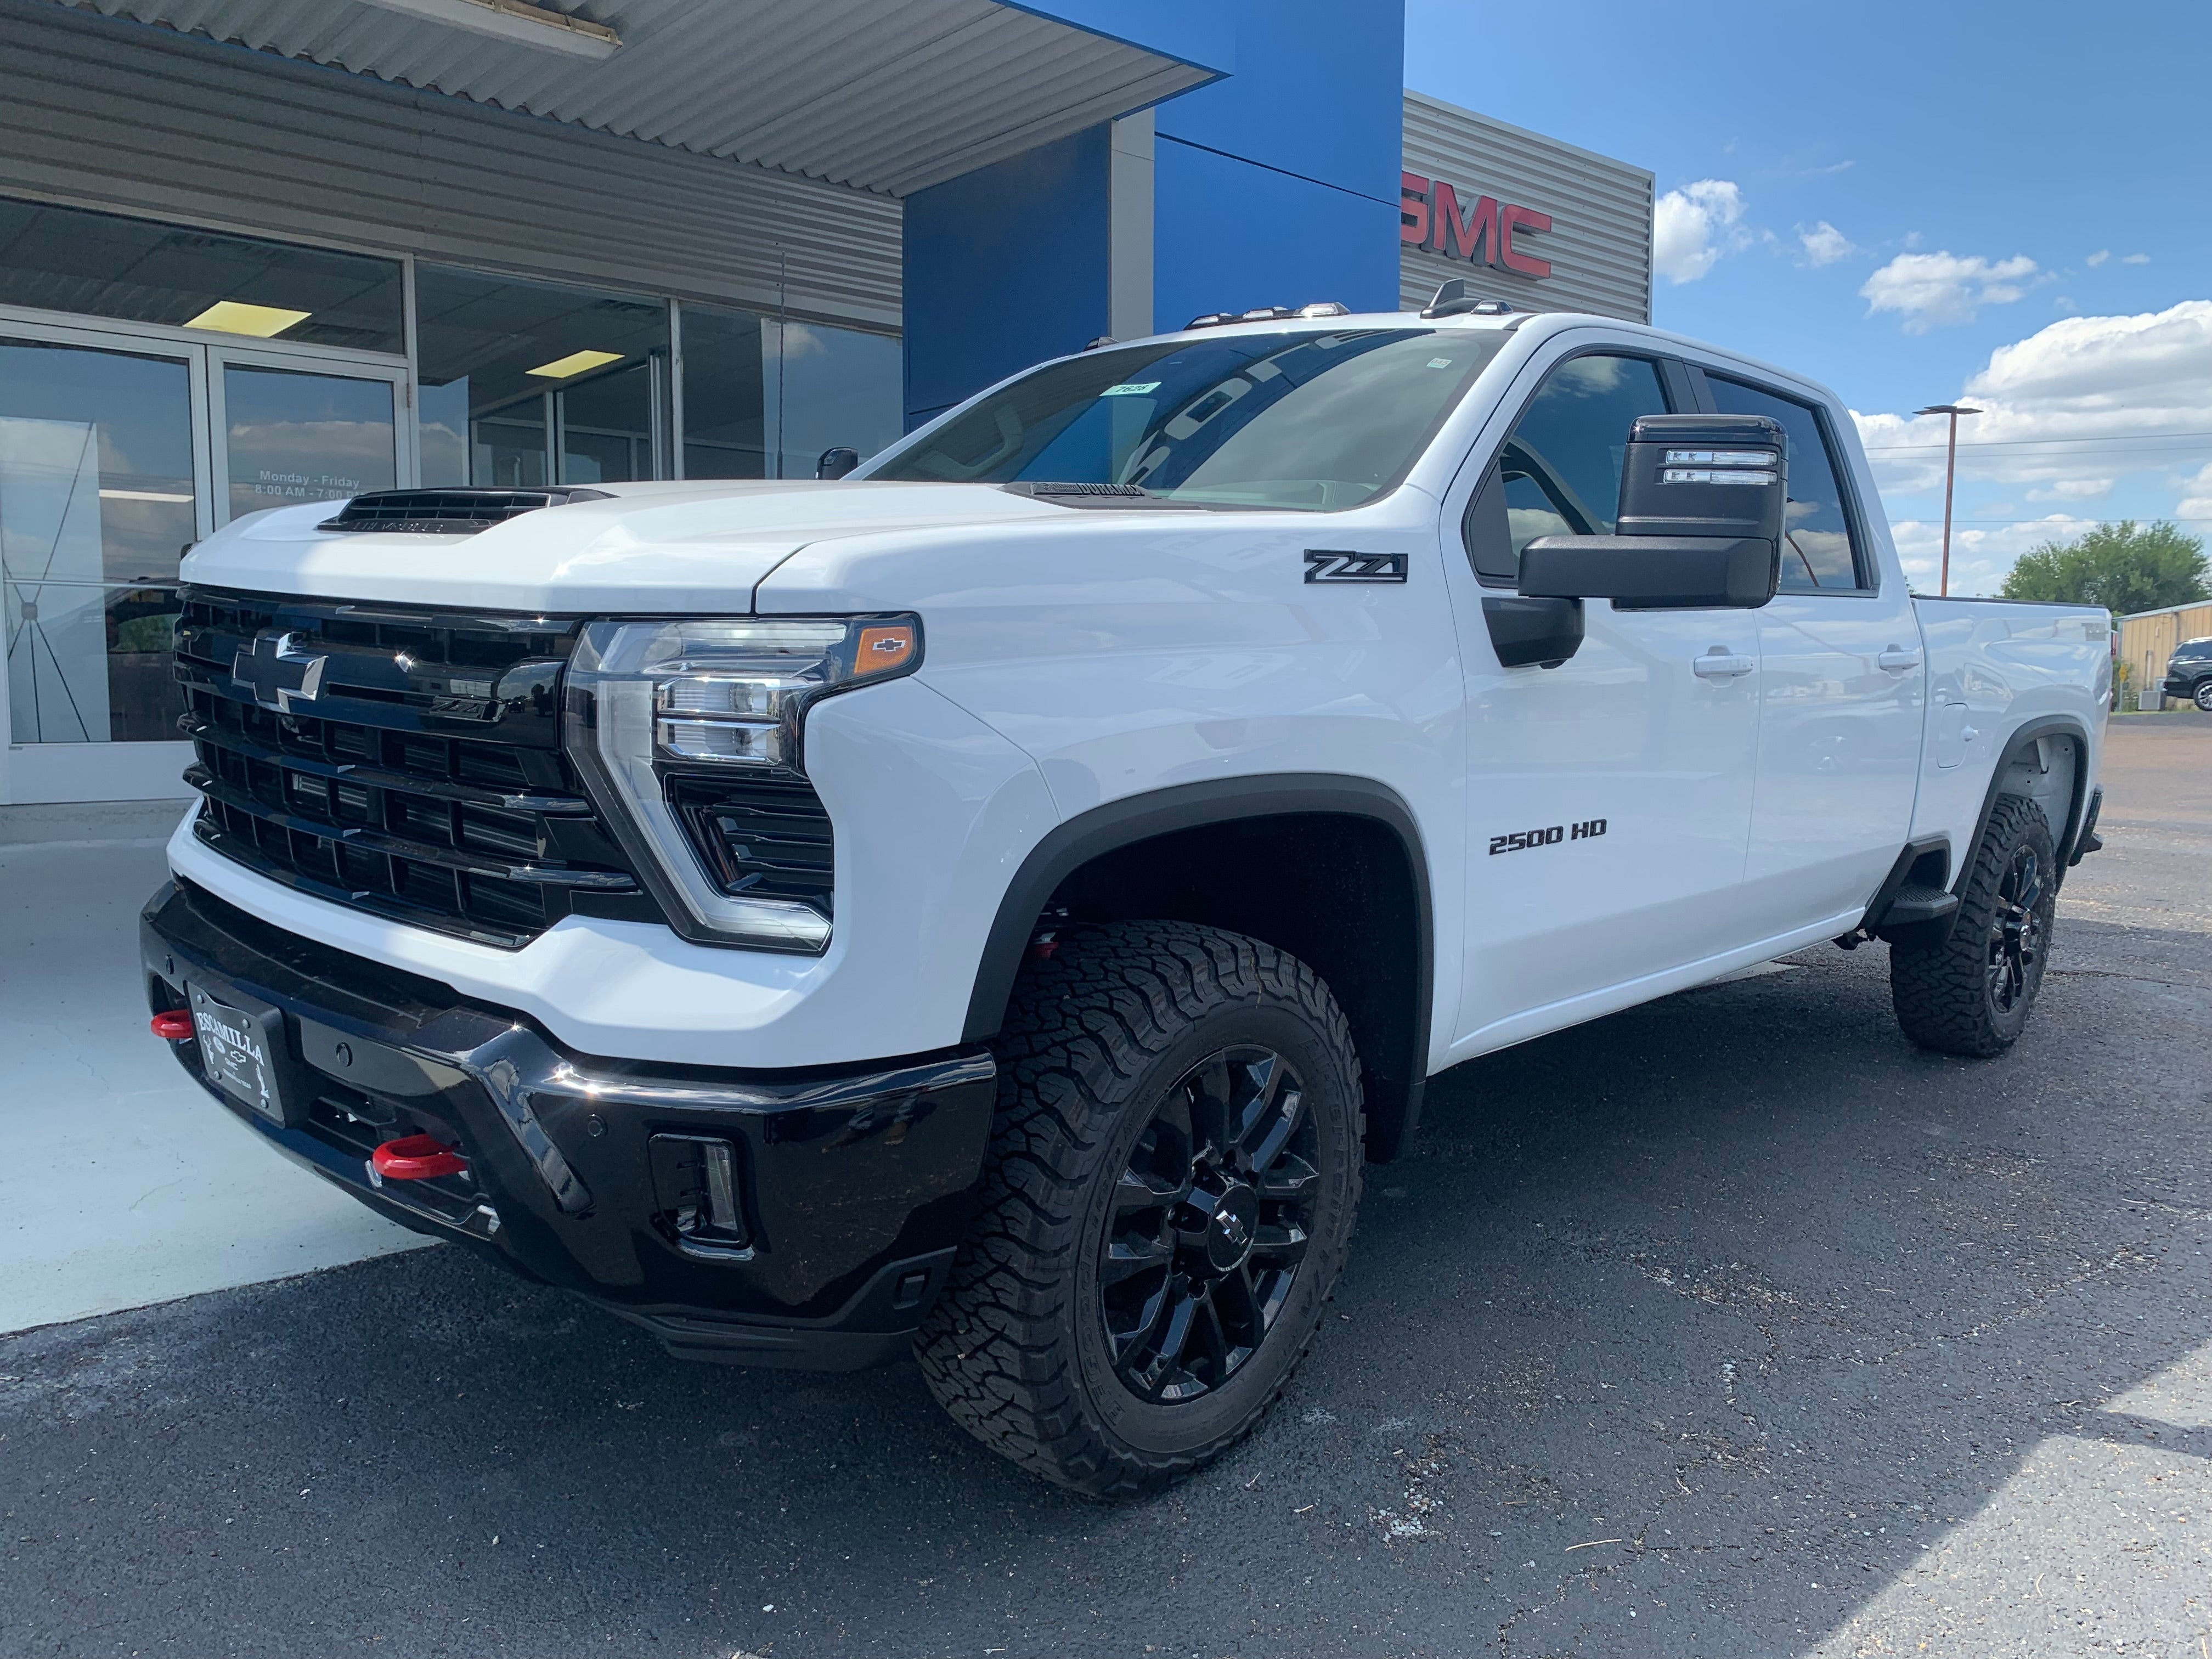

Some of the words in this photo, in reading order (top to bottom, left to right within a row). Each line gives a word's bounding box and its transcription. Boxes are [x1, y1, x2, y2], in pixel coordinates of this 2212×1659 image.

[255, 484, 281, 495] 8:00
[285, 486, 305, 497] AM
[318, 489, 342, 499] 7:00
[260, 470, 309, 484] Monday
[322, 476, 360, 489] Friday
[1076, 483, 1145, 496] DURAMAX
[1304, 549, 1408, 584] Z71
[1489, 826, 1564, 855] 2500
[1571, 819, 1607, 840] HD
[196, 1012, 265, 1066] ESCAMILLA
